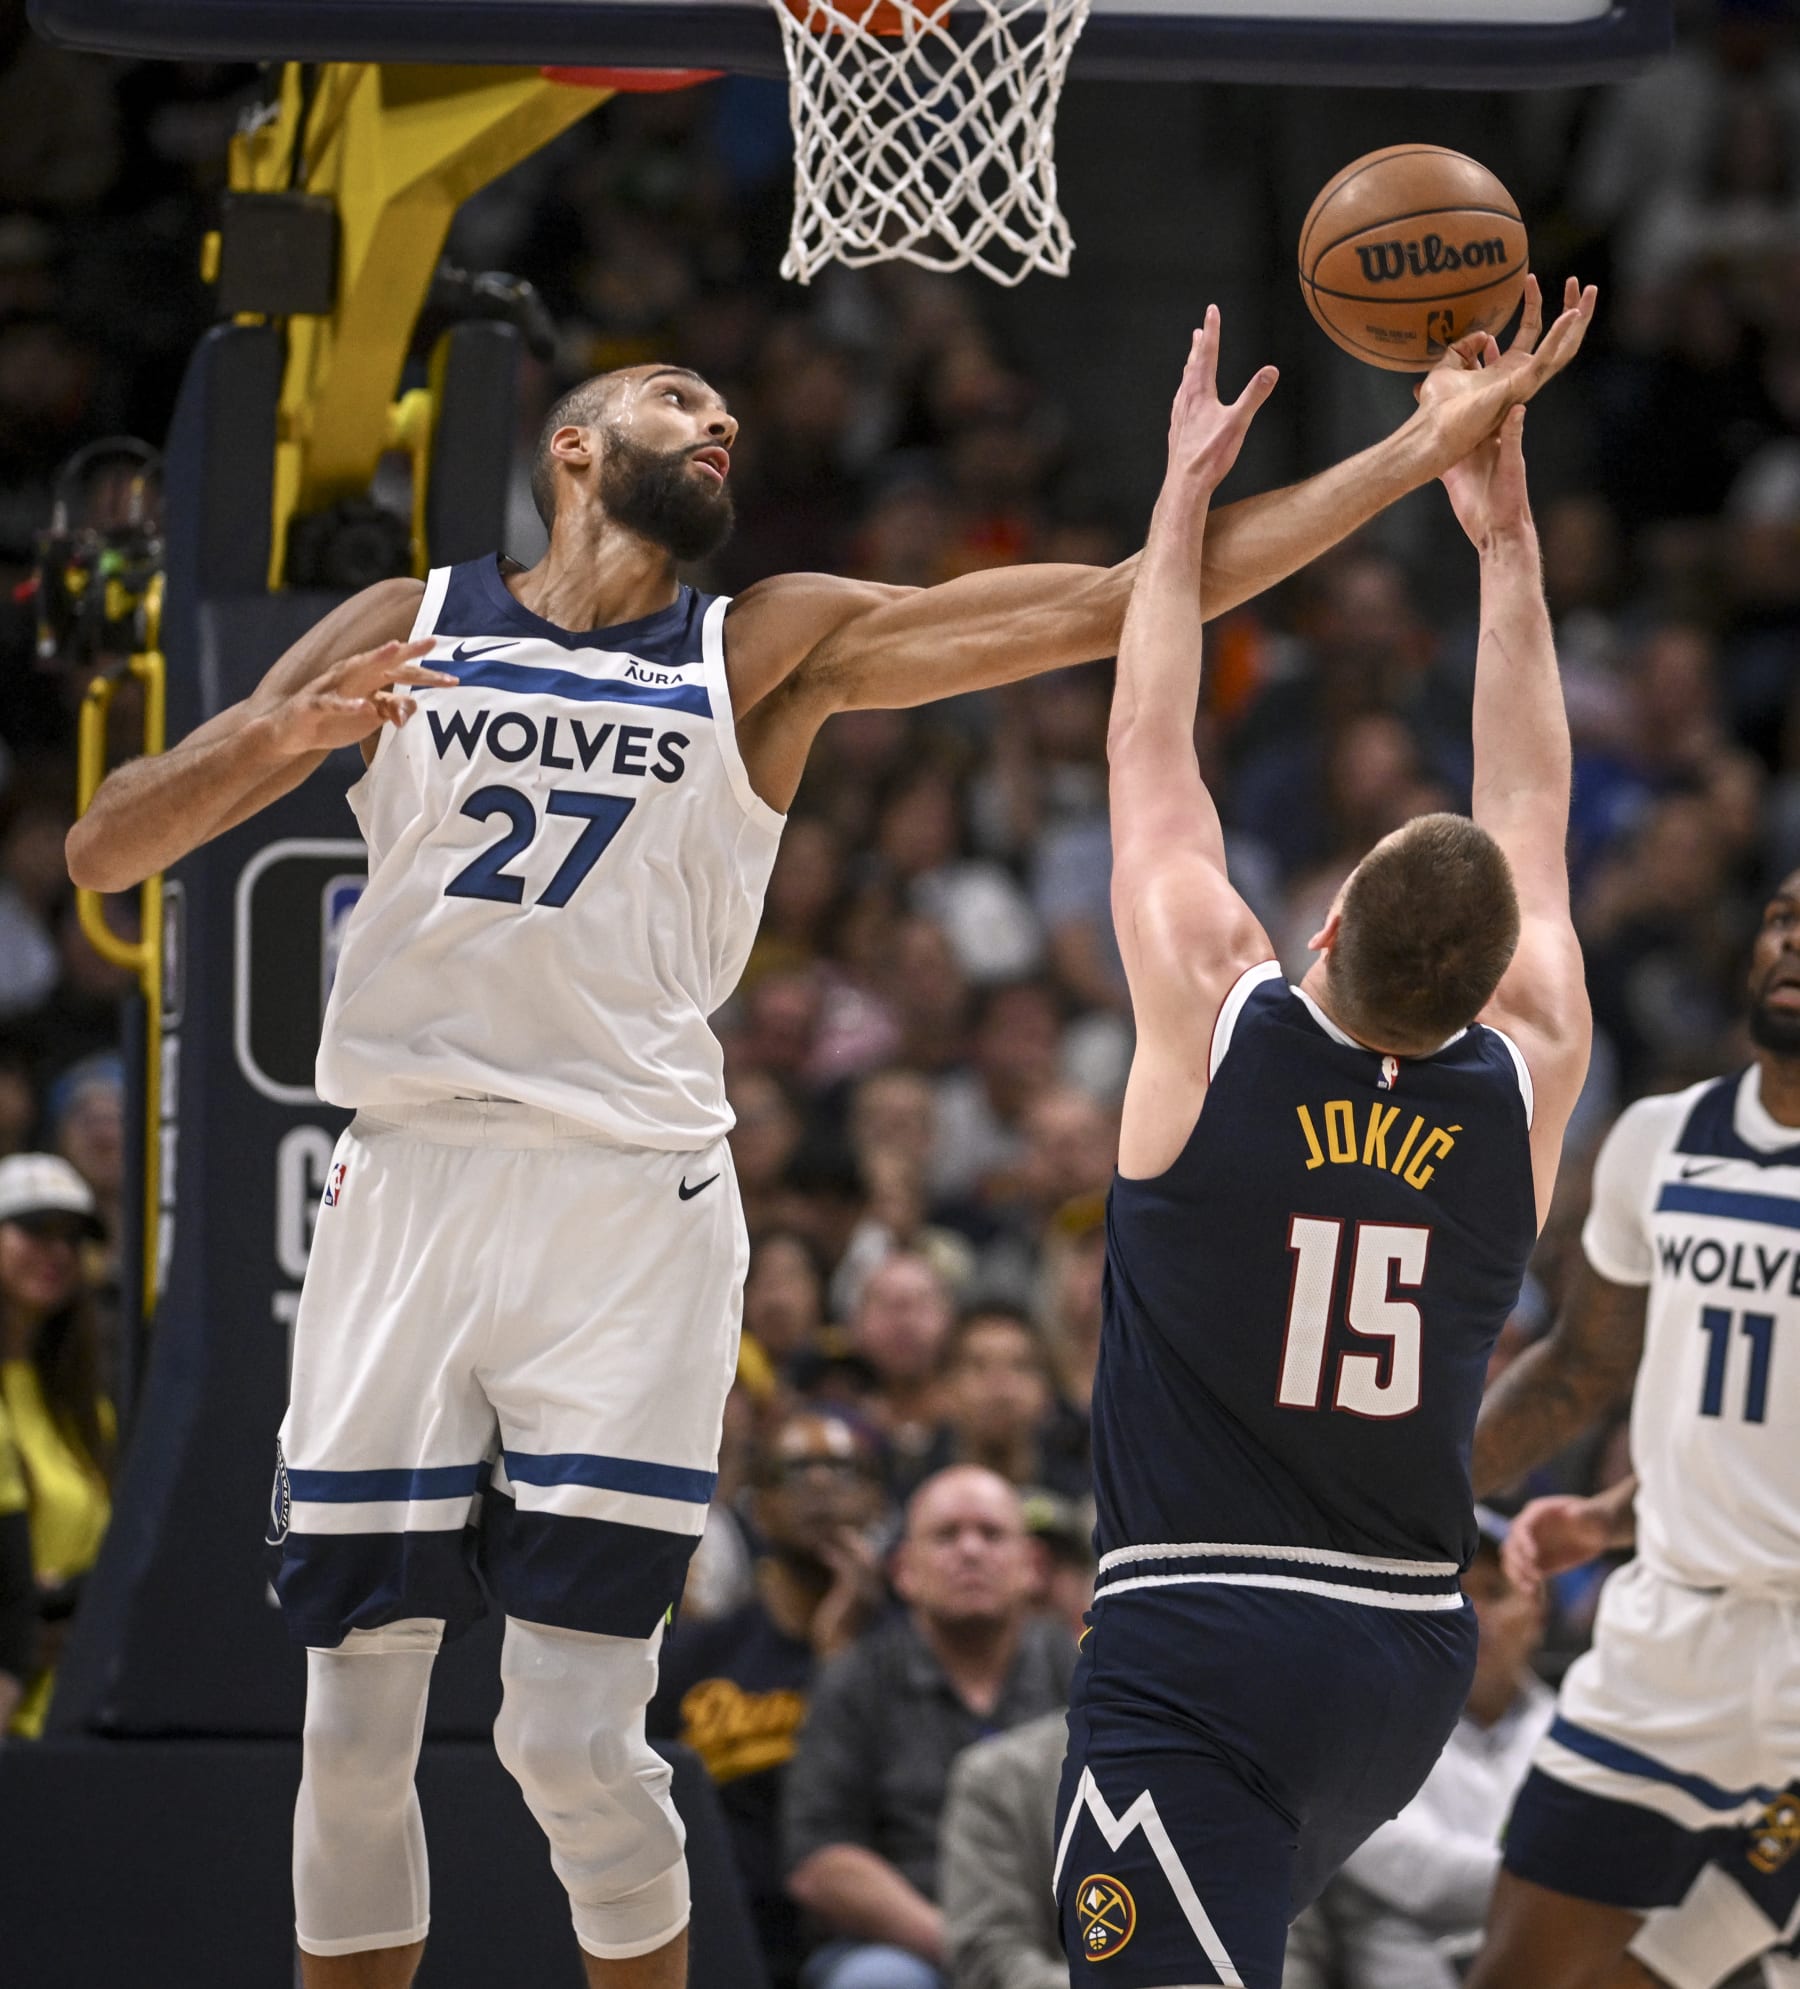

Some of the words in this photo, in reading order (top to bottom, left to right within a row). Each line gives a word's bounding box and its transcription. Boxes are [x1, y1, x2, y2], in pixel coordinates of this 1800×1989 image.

[1356, 234, 1507, 283] Wilson
[426, 709, 690, 783] WOLVES
[444, 784, 636, 908] 27
[1296, 1100, 1463, 1190] JOKIĆ
[1275, 1213, 1433, 1420] 15
[1699, 1304, 1776, 1425] 11
